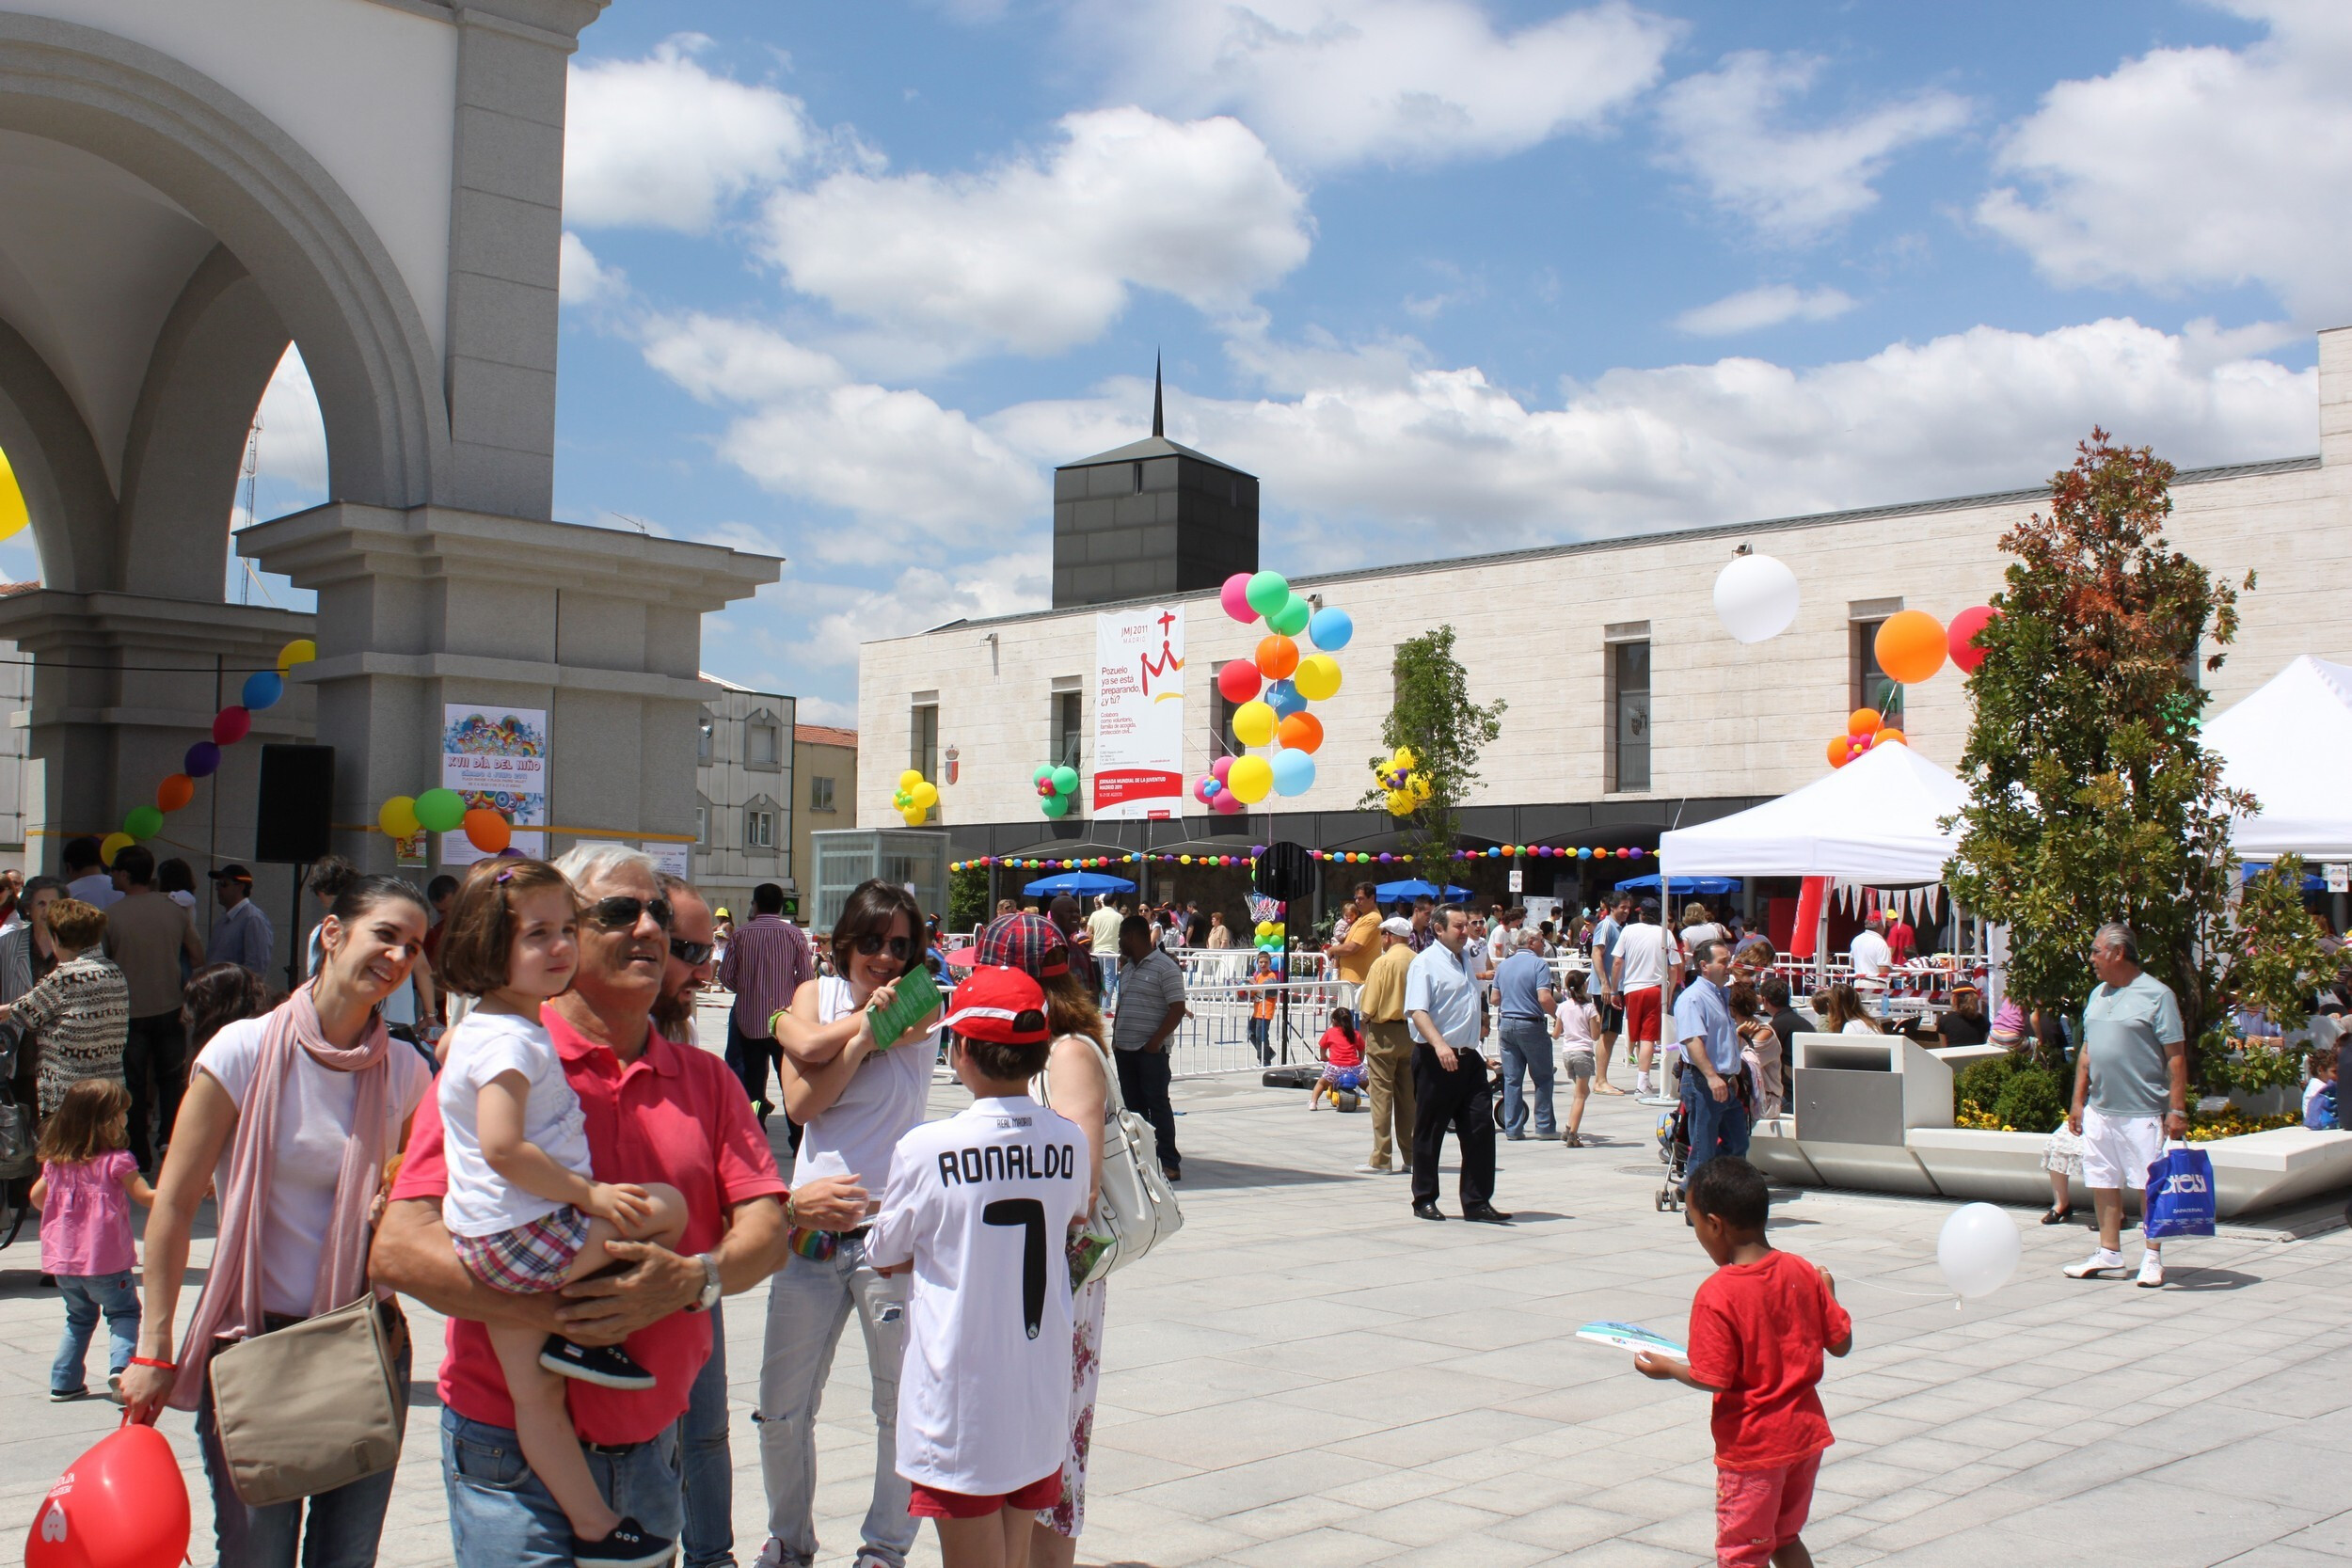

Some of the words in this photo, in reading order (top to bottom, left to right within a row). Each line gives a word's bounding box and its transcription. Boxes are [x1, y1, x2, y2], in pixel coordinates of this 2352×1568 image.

[1121, 626, 1133, 637] JMJ
[1134, 626, 1148, 634] 2011
[1102, 666, 1128, 675] Pozuelo
[1101, 678, 1109, 687] ya
[1120, 675, 1134, 684] está
[1101, 685, 1141, 696] preparando,
[1101, 697, 1109, 706] ¿y
[1110, 695, 1120, 704] tú?
[448, 756, 469, 768] XVII
[473, 756, 490, 768] DÍA
[494, 759, 513, 770] DEL
[516, 759, 541, 771] NIÑO
[996, 1117, 1010, 1128] REAL
[1011, 1117, 1032, 1128] MADRID
[938, 1144, 1073, 1188] RONALDO
[982, 1198, 1047, 1340] 7
